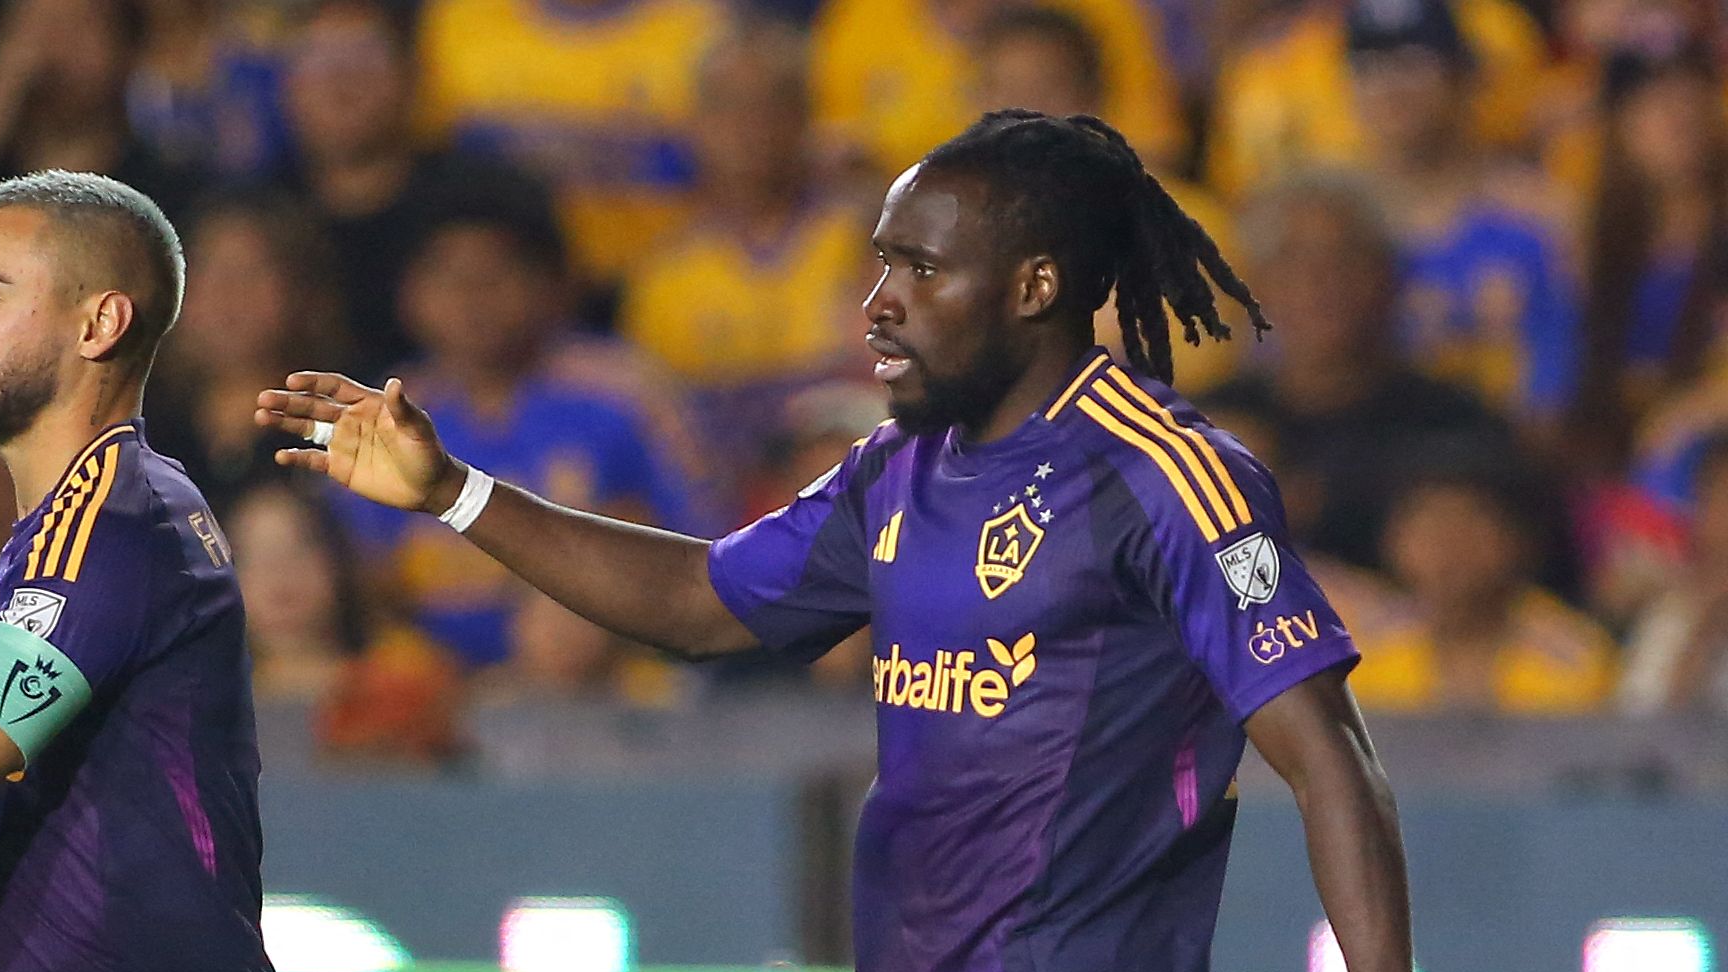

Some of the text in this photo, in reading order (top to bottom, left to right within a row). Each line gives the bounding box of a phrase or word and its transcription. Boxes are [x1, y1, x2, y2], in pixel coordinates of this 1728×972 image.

[988, 536, 1020, 564] LA
[1225, 547, 1253, 569] MLS
[15, 595, 39, 607] MLS
[1276, 610, 1320, 648] tv
